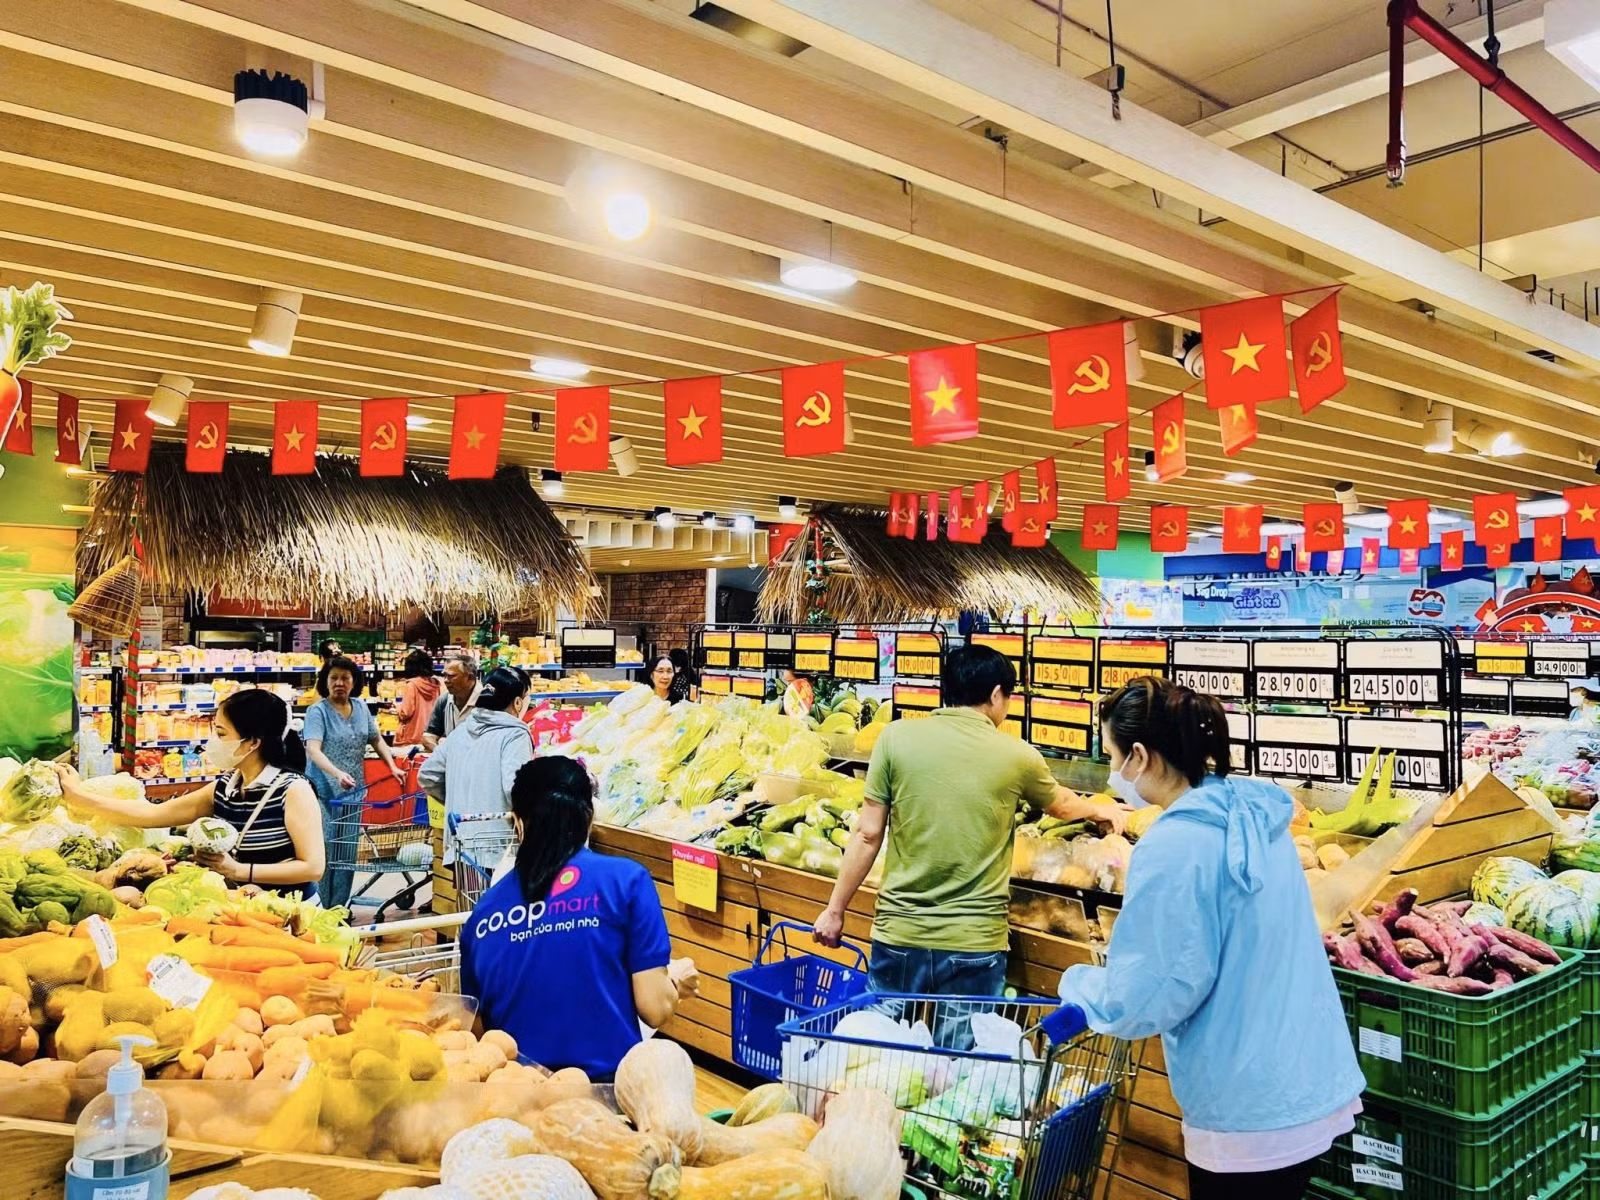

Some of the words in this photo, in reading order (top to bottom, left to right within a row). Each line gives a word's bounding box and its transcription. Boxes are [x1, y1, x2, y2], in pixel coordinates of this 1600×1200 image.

[1536, 662, 1576, 673] 34.900
[1177, 673, 1230, 691] 56.000
[1258, 676, 1318, 693] 28.900
[1353, 678, 1419, 696] 24.500
[1261, 751, 1320, 769] 22.500
[1356, 757, 1422, 777] 1.00
[510, 929, 532, 942] bạn
[533, 922, 553, 936] của
[555, 918, 575, 933] mọi
